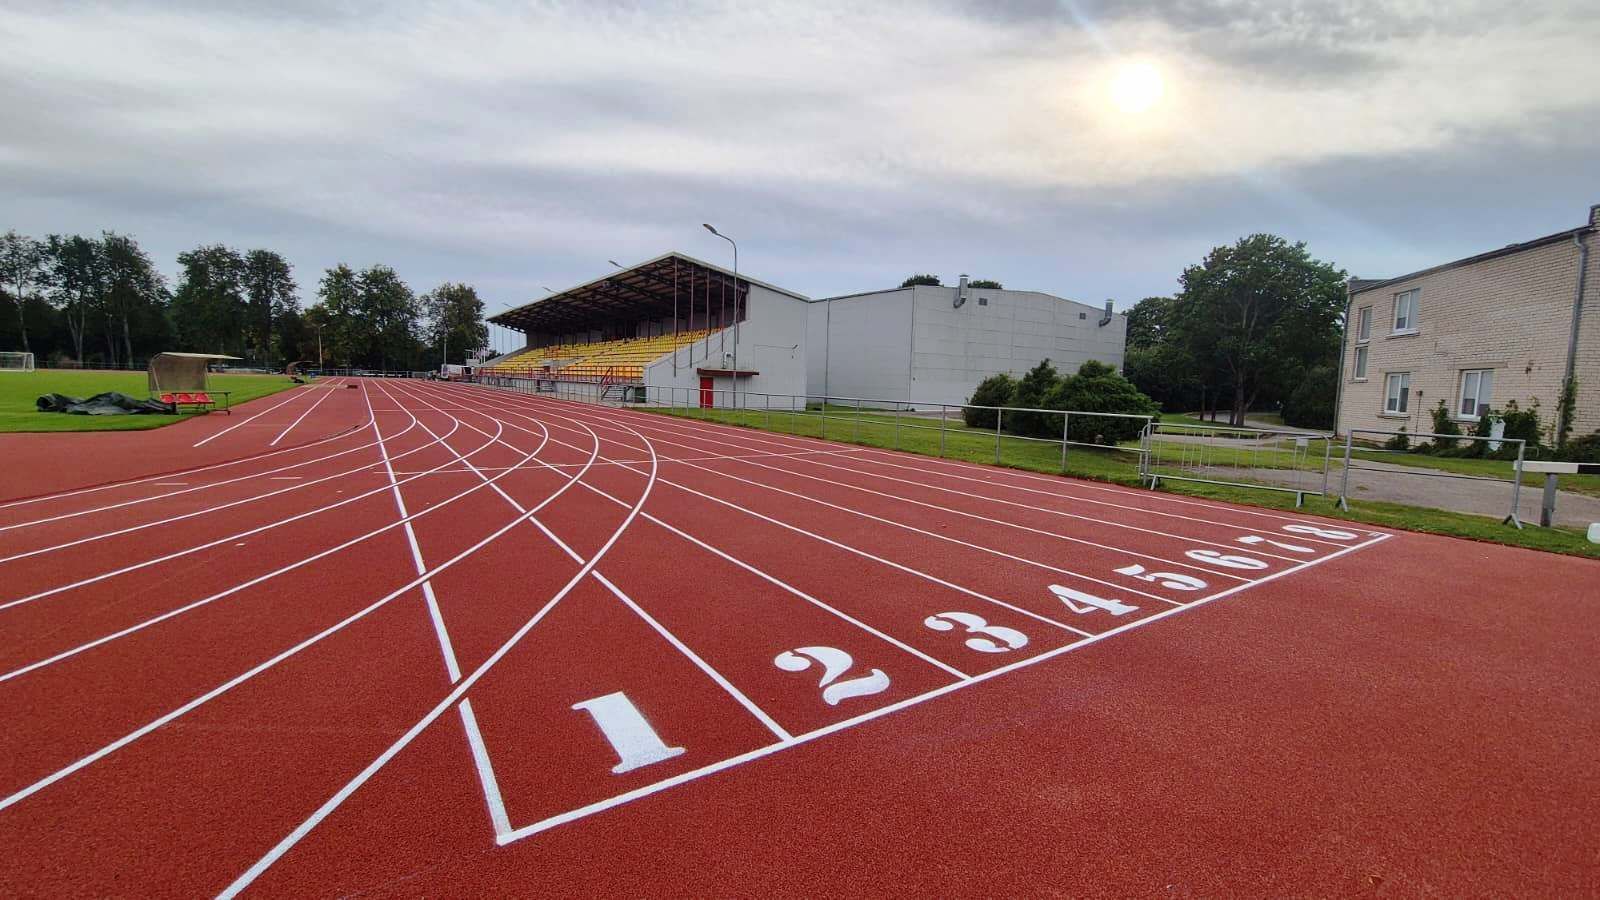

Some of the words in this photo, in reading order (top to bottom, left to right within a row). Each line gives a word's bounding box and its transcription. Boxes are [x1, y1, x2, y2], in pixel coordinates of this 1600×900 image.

[1233, 535, 1317, 553] 7
[1281, 524, 1359, 541] 8
[1184, 549, 1270, 570] 6
[1111, 563, 1208, 590] 5
[1047, 583, 1141, 616] 4
[923, 611, 1031, 653] 3
[773, 645, 891, 706] 2
[570, 690, 687, 774] 1
